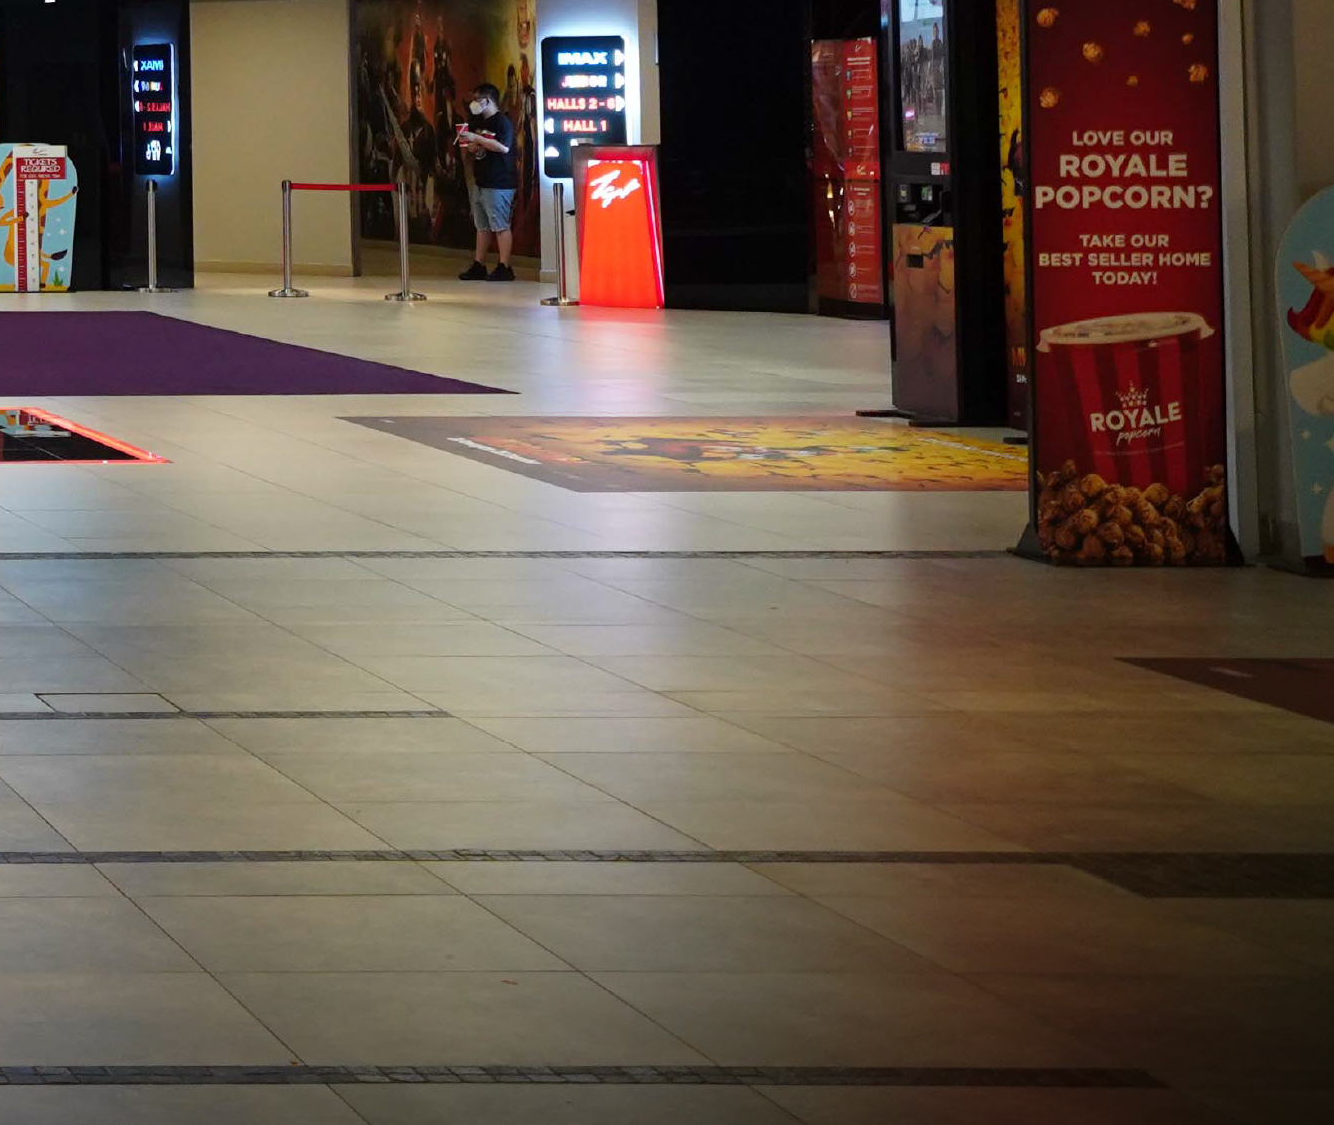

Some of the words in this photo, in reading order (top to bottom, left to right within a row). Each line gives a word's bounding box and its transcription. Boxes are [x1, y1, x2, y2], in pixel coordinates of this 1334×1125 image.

[557, 52, 607, 66] IMAX
[547, 98, 587, 110] HALLS
[588, 97, 598, 110] 2
[563, 120, 597, 132] HALL
[599, 120, 607, 132] 1
[1072, 130, 1125, 146] LOVE
[1130, 130, 1174, 146] OUR
[20, 165, 61, 173] REQUIRED
[1059, 154, 1188, 178] ROYALE
[1035, 185, 1213, 209] POPCORN?
[1079, 234, 1126, 248] TAKE
[1130, 234, 1170, 248] OUR
[1038, 252, 1083, 267] BEST
[1087, 252, 1154, 267] SELLER
[1158, 252, 1212, 267] HOME
[1091, 272, 1158, 285] TODAY!
[1090, 402, 1182, 432] ROYALE
[1116, 426, 1161, 446] popcorn
